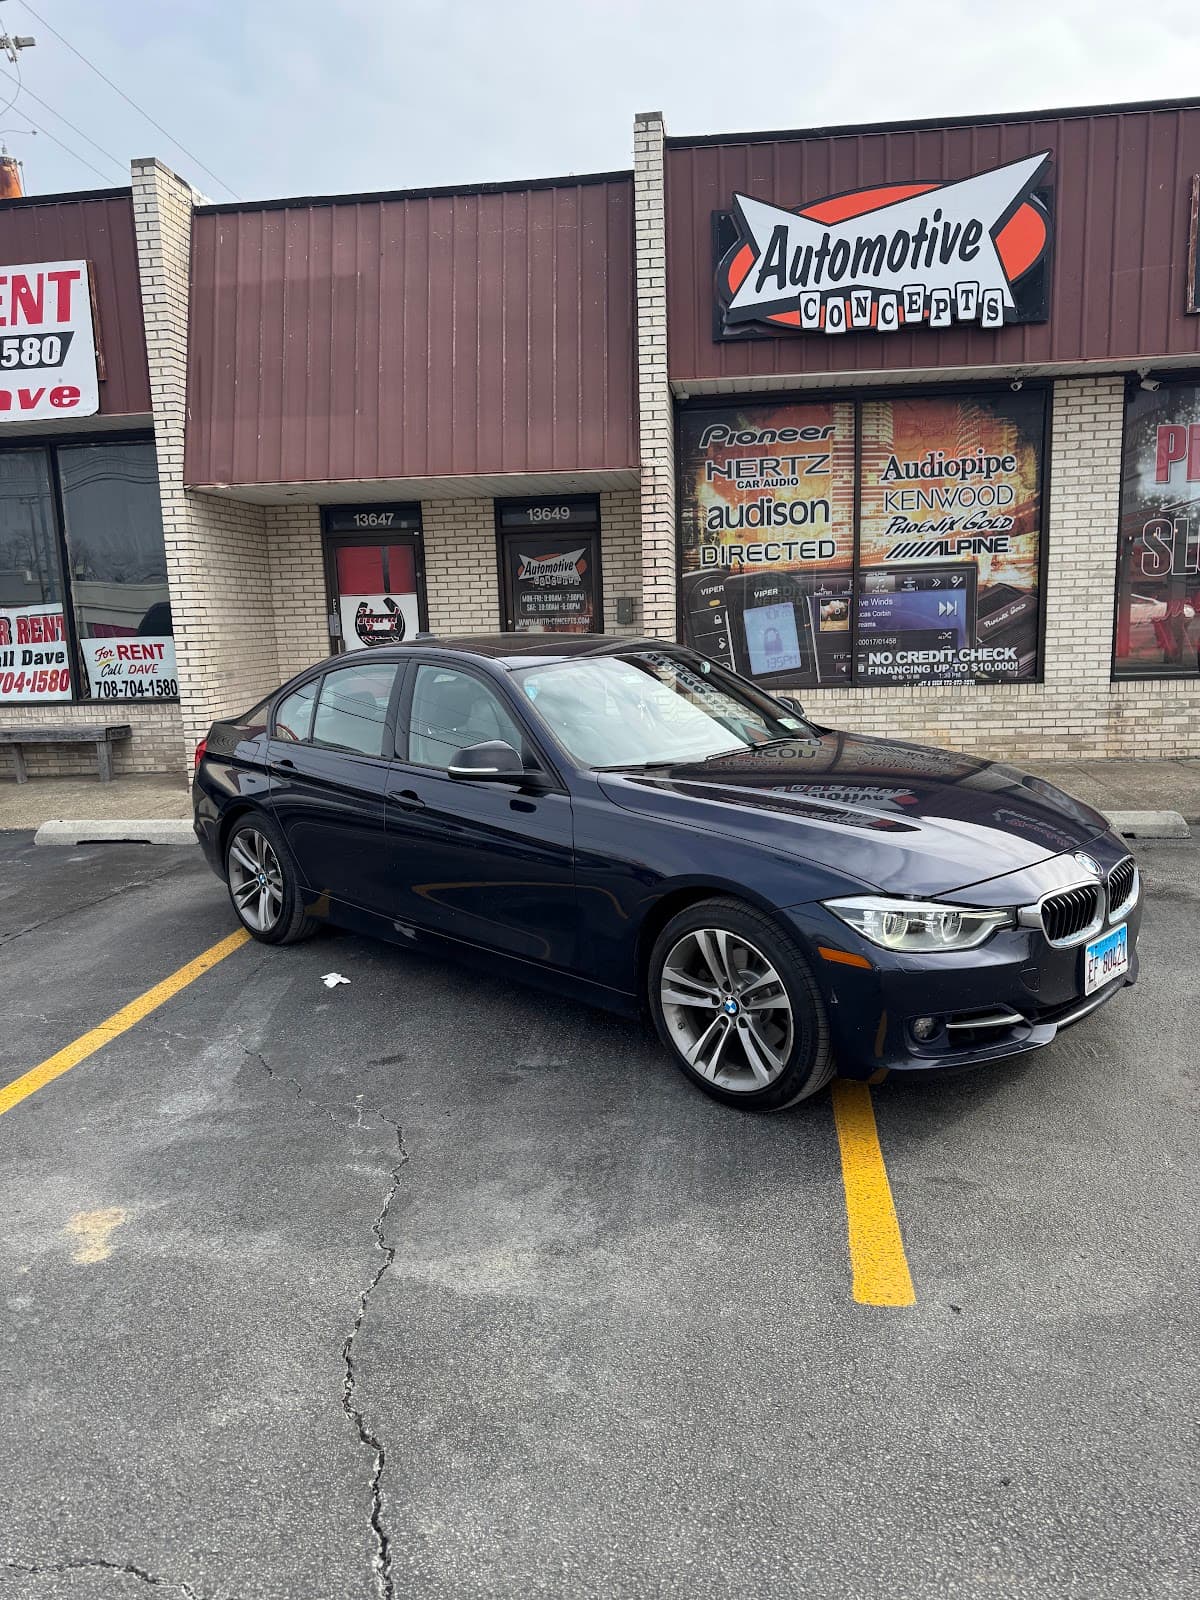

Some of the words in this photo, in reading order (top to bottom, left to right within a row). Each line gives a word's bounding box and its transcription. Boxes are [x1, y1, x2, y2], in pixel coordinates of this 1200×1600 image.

[754, 207, 983, 294] Automotive
[801, 286, 1001, 329] CONCEPTS
[699, 424, 836, 448] Pioneer
[705, 454, 832, 482] HERTZ
[880, 448, 1016, 482] Audiopipe
[737, 480, 761, 490] CAR
[762, 477, 799, 488] AUDIO
[884, 485, 1015, 512] KENWOOD
[353, 512, 395, 527] 13647
[526, 506, 571, 521] 13649
[707, 497, 831, 530] audison
[701, 539, 836, 567] DIRECTED
[912, 536, 1010, 557] ALPINE
[523, 558, 574, 577] Automotive
[700, 584, 725, 596] VIPER
[753, 587, 779, 599] VIPER
[16, 614, 66, 645] RENT
[22, 650, 65, 666] Dave
[94, 646, 115, 662] For
[117, 644, 165, 661] RENT
[868, 652, 894, 665] NO
[895, 650, 955, 664] CREDIT
[958, 647, 1018, 662] CHECK
[101, 663, 123, 677] Call
[127, 664, 159, 675] DAVE
[867, 664, 932, 675] FINANCING
[933, 663, 950, 673] UP
[954, 663, 969, 672] TO
[971, 661, 1019, 673] $10,000!
[95, 678, 178, 698] 708-704-1580
